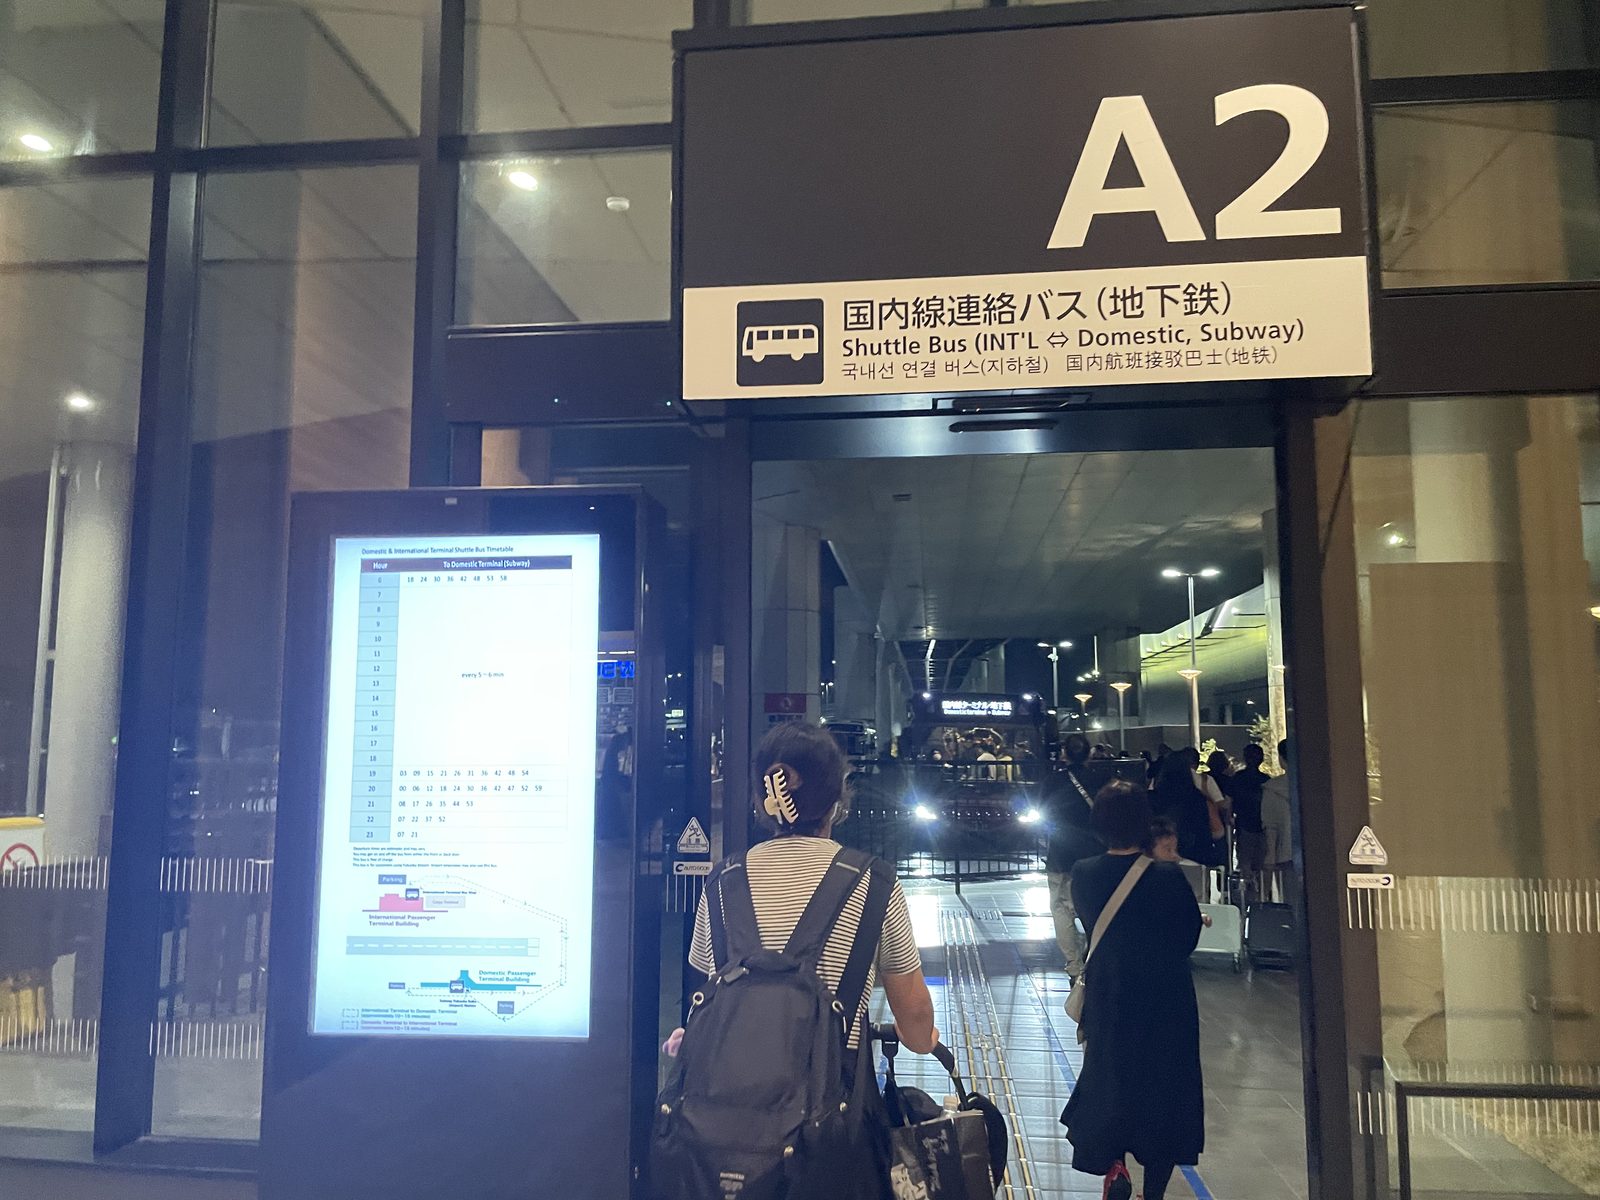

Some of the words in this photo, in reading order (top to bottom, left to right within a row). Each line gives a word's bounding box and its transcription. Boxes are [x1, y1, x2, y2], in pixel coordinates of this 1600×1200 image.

[1046, 83, 1342, 249] A2
[842, 335, 921, 357] Shuttle
[929, 335, 967, 354] Bus
[974, 331, 1039, 355] (INT'L
[1078, 324, 1191, 347] Domestic,
[1200, 319, 1304, 343] Subway)
[842, 361, 894, 381] 국내선
[902, 359, 936, 379] 연결
[944, 355, 1049, 377] 버스(지하철)
[1066, 345, 1278, 372] 国内航班接驳巴士(地铁)
[486, 545, 514, 553] Timetable
[373, 561, 388, 570] Hour
[443, 560, 451, 568] To
[451, 560, 478, 568] Domestic
[478, 559, 503, 568] Terminal
[503, 559, 531, 568] (Subway)
